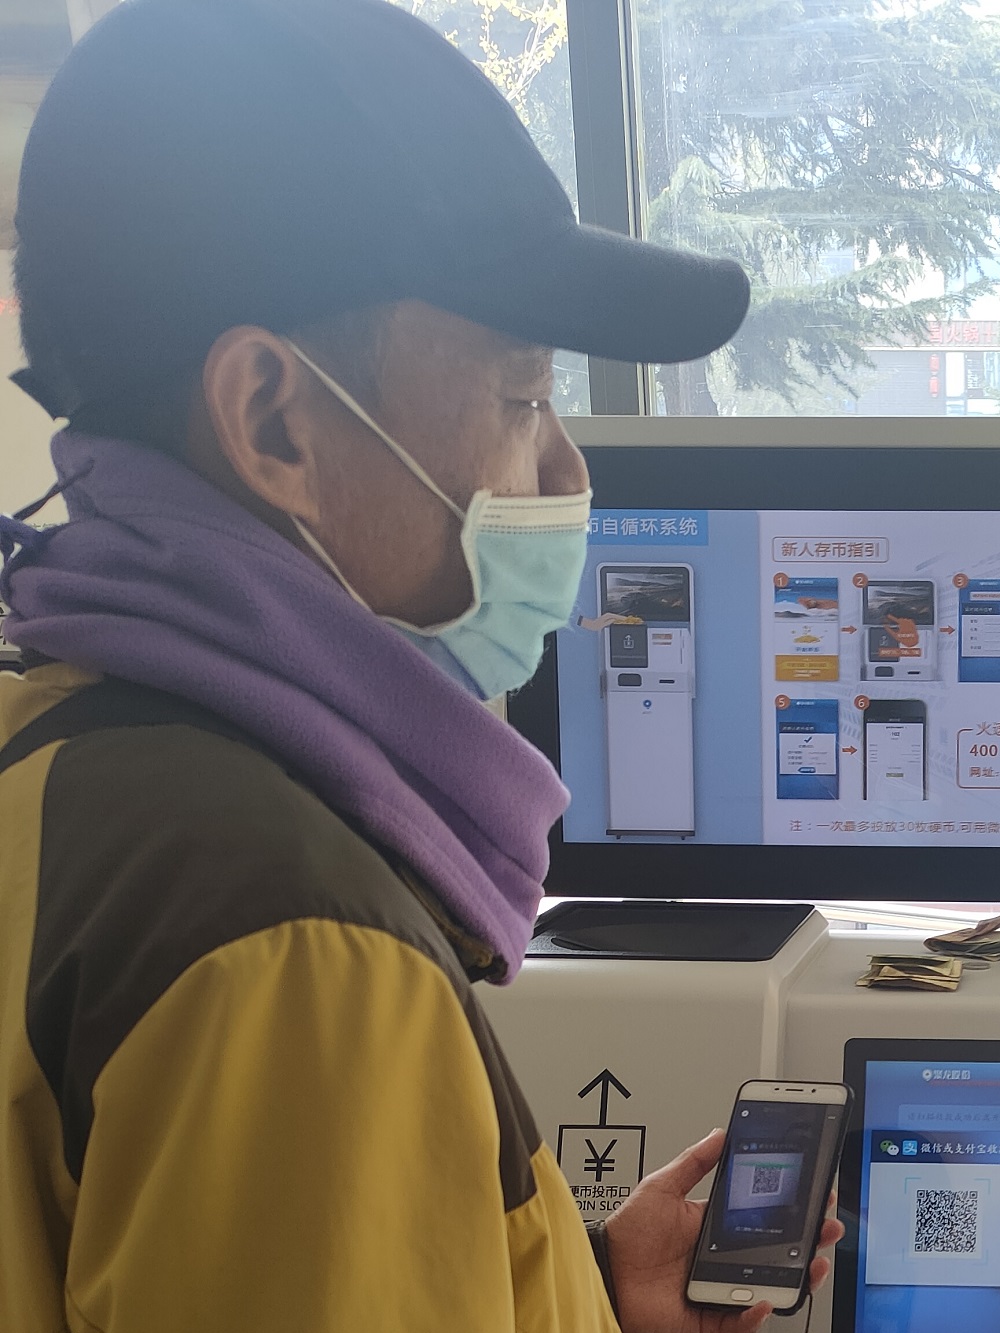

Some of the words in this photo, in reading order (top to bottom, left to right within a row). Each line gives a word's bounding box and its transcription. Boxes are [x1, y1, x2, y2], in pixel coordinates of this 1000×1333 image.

[781, 541, 880, 558] 新人存币指引
[969, 744, 998, 757] 400
[600, 1200, 625, 1211] SLO
